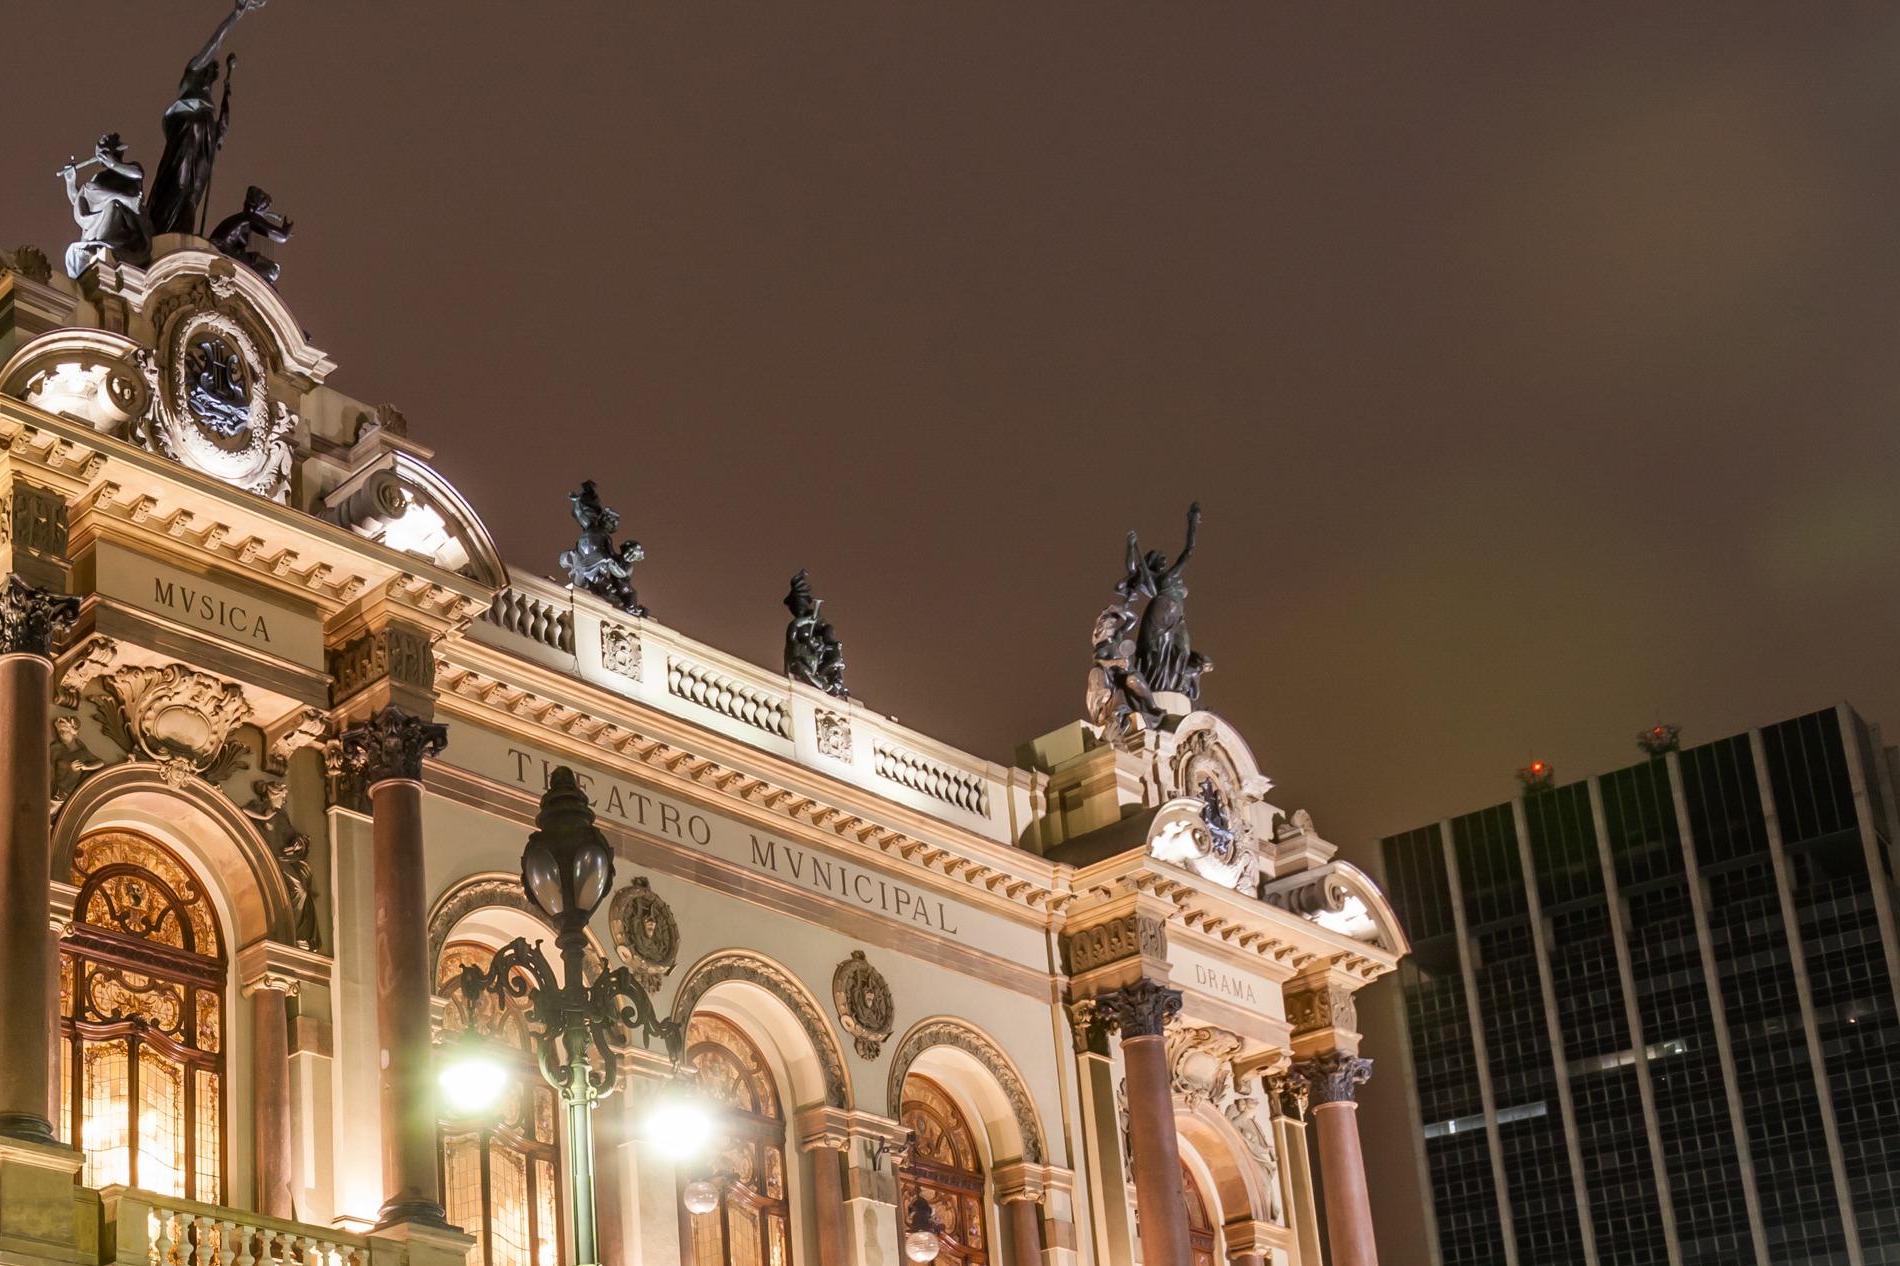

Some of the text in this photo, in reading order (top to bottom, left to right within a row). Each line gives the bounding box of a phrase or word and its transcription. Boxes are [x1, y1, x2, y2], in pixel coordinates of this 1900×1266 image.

[155, 577, 271, 642] MVSICA
[750, 833, 958, 936] MVNICIPAL
[1195, 964, 1257, 1005] DRAMA
